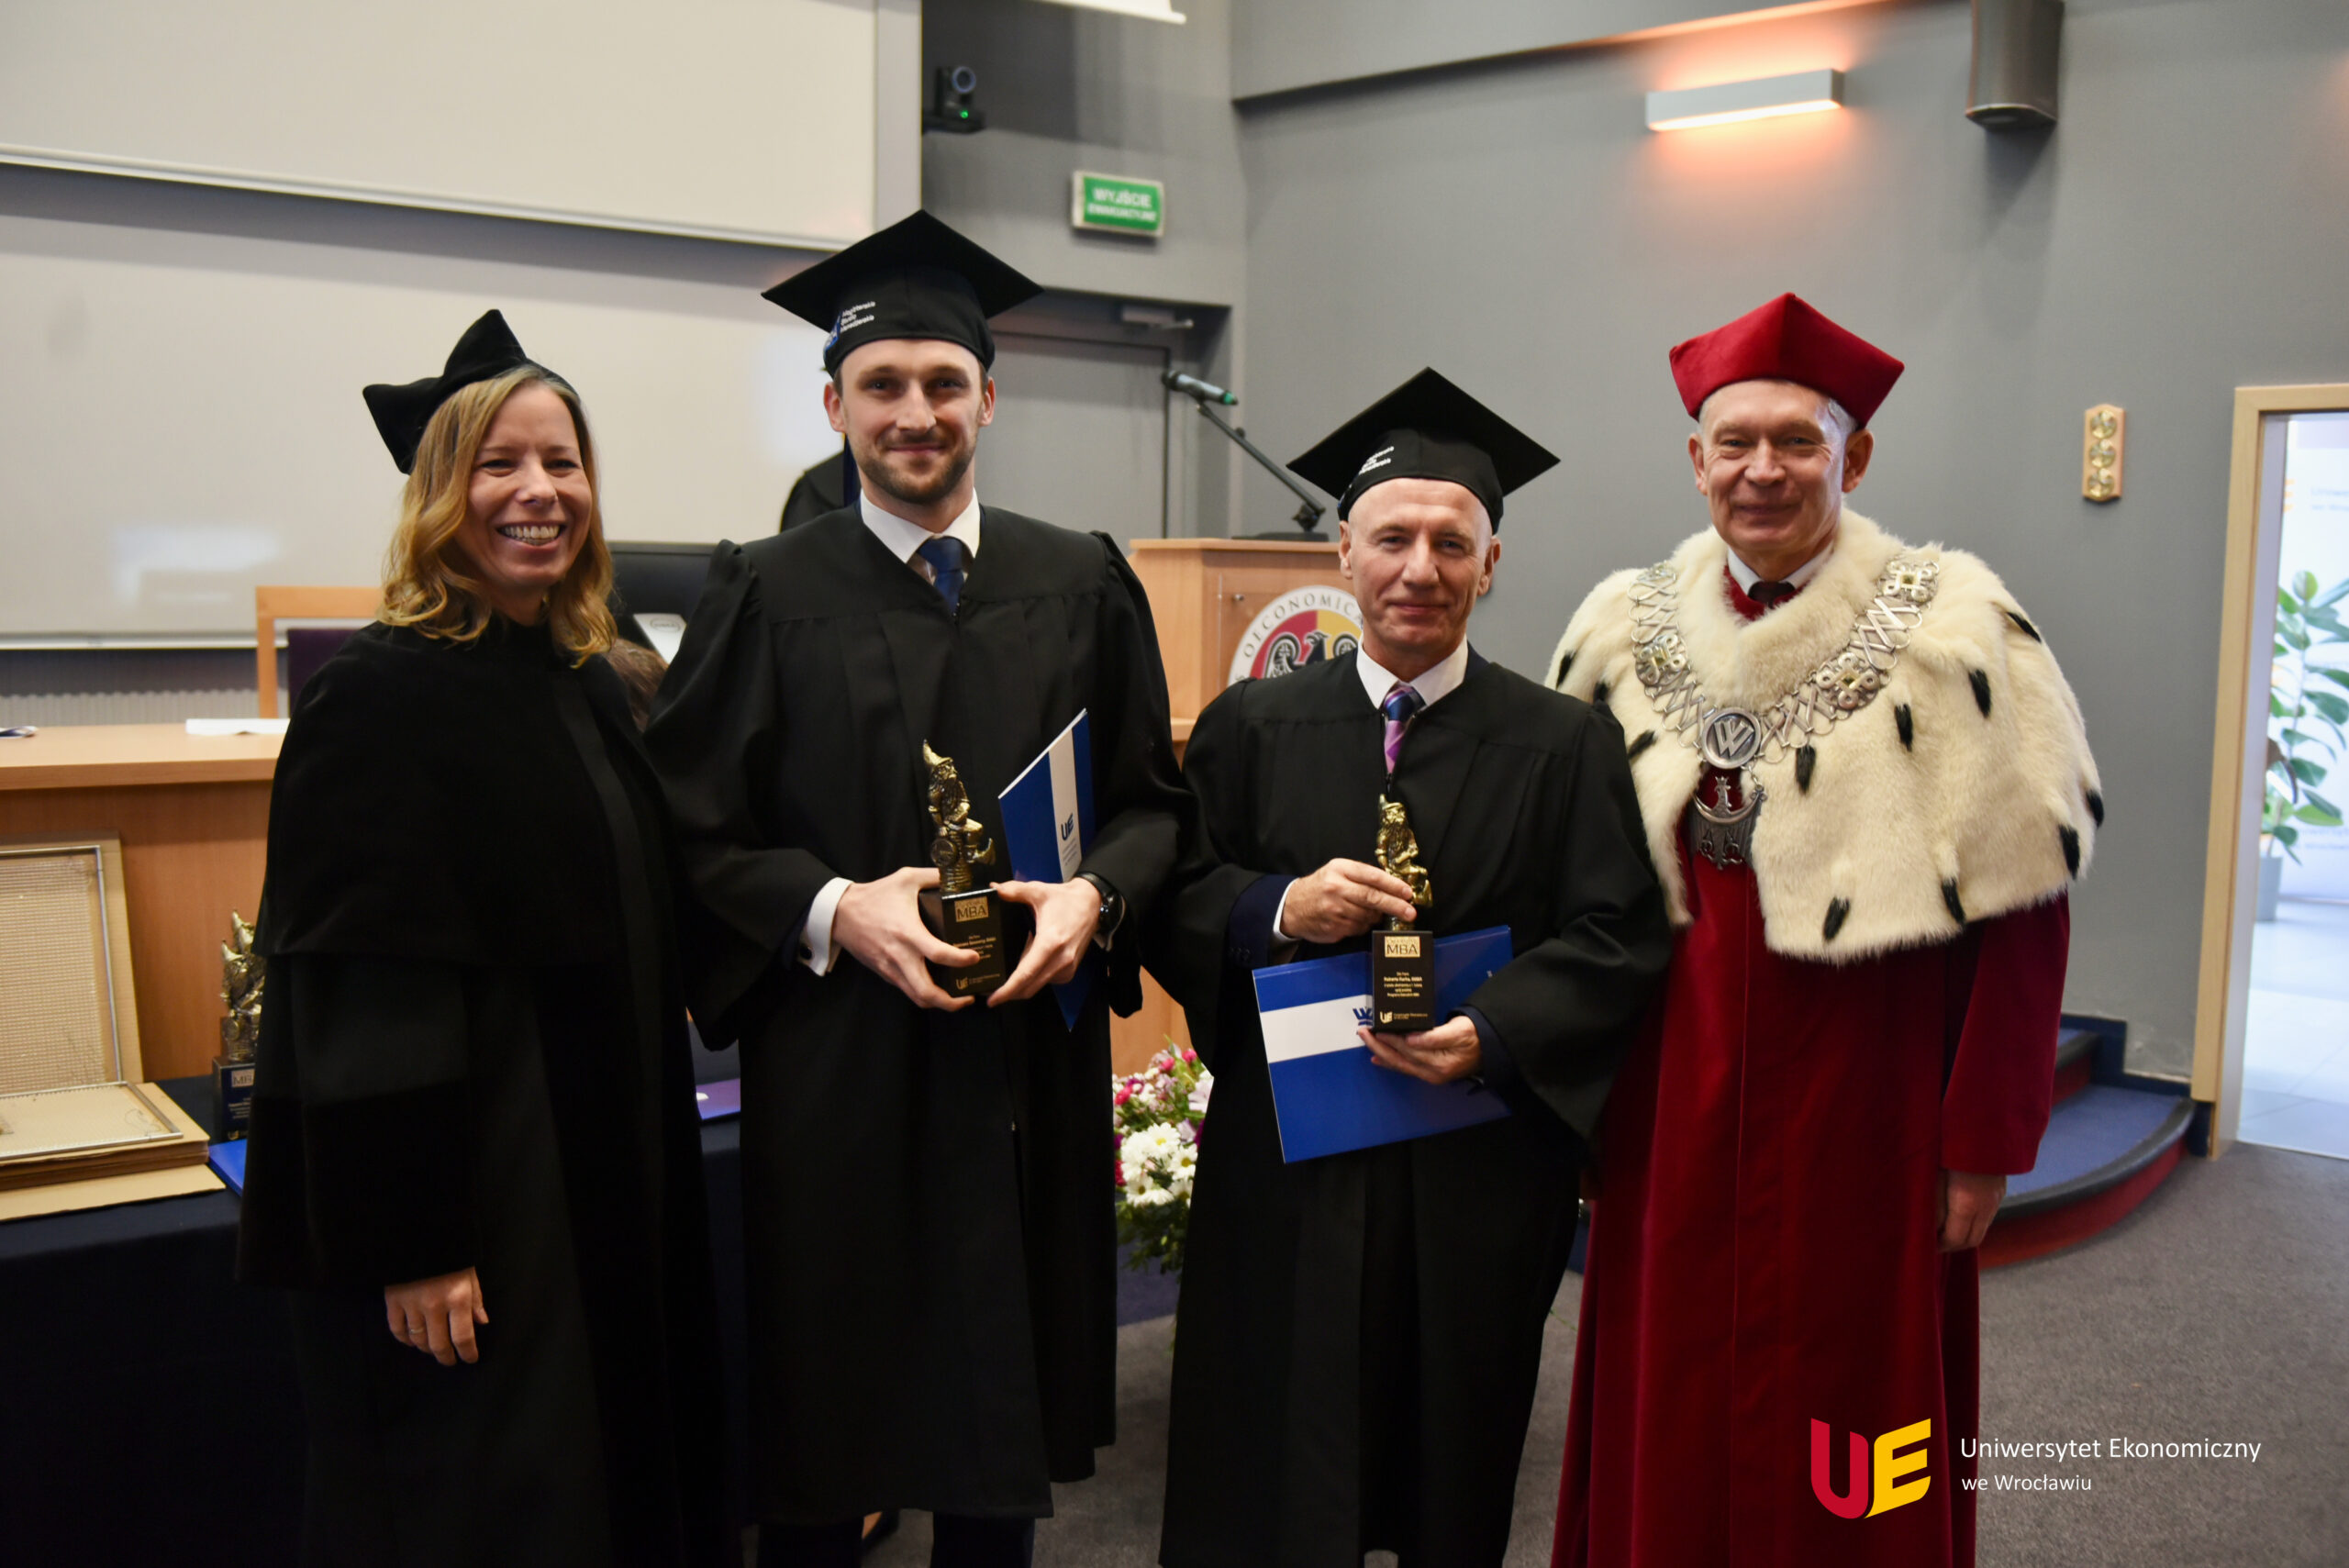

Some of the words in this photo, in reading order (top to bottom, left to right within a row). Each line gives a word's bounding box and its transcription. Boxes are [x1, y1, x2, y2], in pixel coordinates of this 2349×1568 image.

[1093, 187, 1152, 207] WYJŚCIE
[1061, 813, 1074, 840] UE
[957, 905, 986, 920] MBA
[1386, 944, 1418, 955] MBA
[233, 1074, 252, 1085] MB
